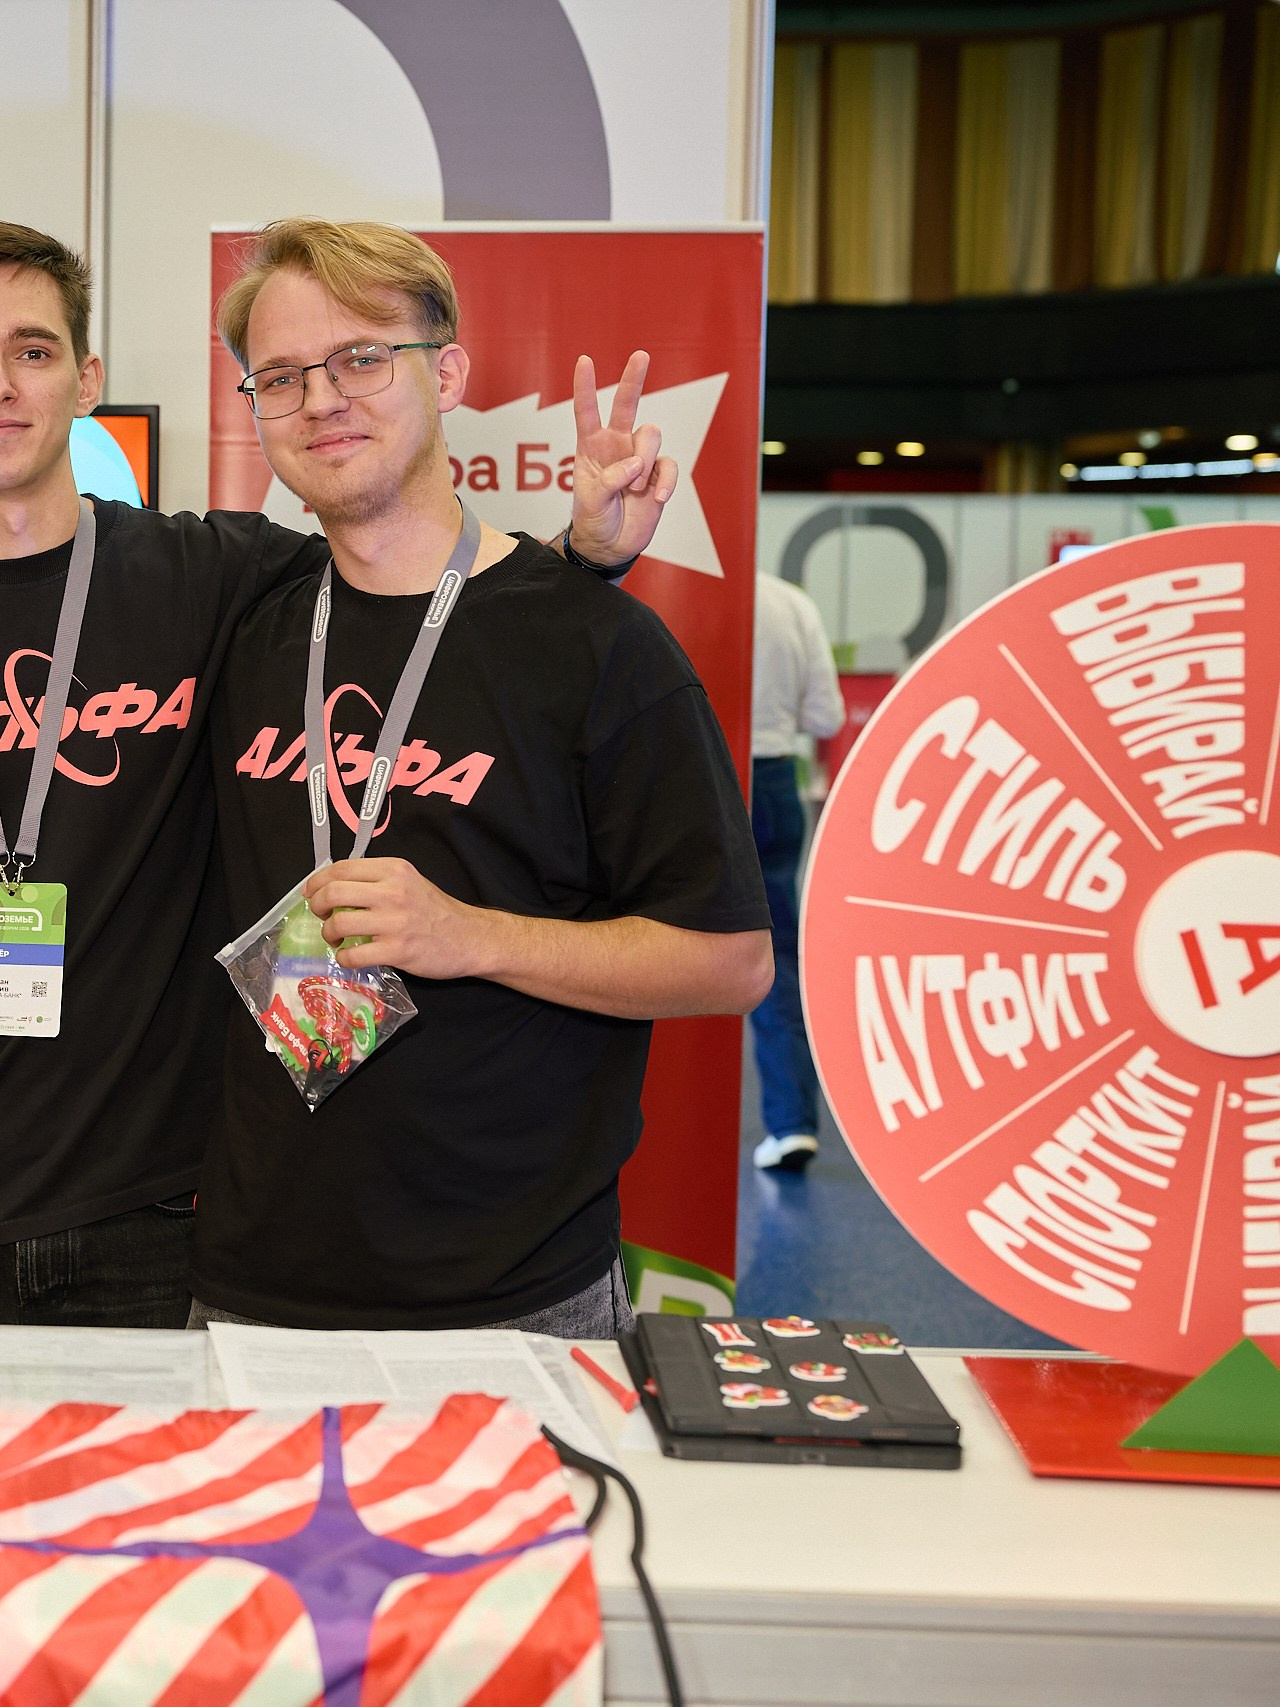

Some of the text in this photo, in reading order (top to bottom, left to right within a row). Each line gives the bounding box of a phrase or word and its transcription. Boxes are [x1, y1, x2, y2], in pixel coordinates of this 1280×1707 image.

[516, 442, 575, 492] Ба
[431, 575, 455, 621] ЦИФРОЗЕМЬЕ
[1050, 562, 1261, 839] ВЫБИРАЙ
[236, 727, 495, 806] АЛЬФА
[871, 695, 1127, 913] СТИЛЬ
[271, 1011, 309, 1062] льфа Банк
[855, 952, 1108, 1133] АУТФИТ
[966, 1046, 1200, 1312] СПОРТКИТ
